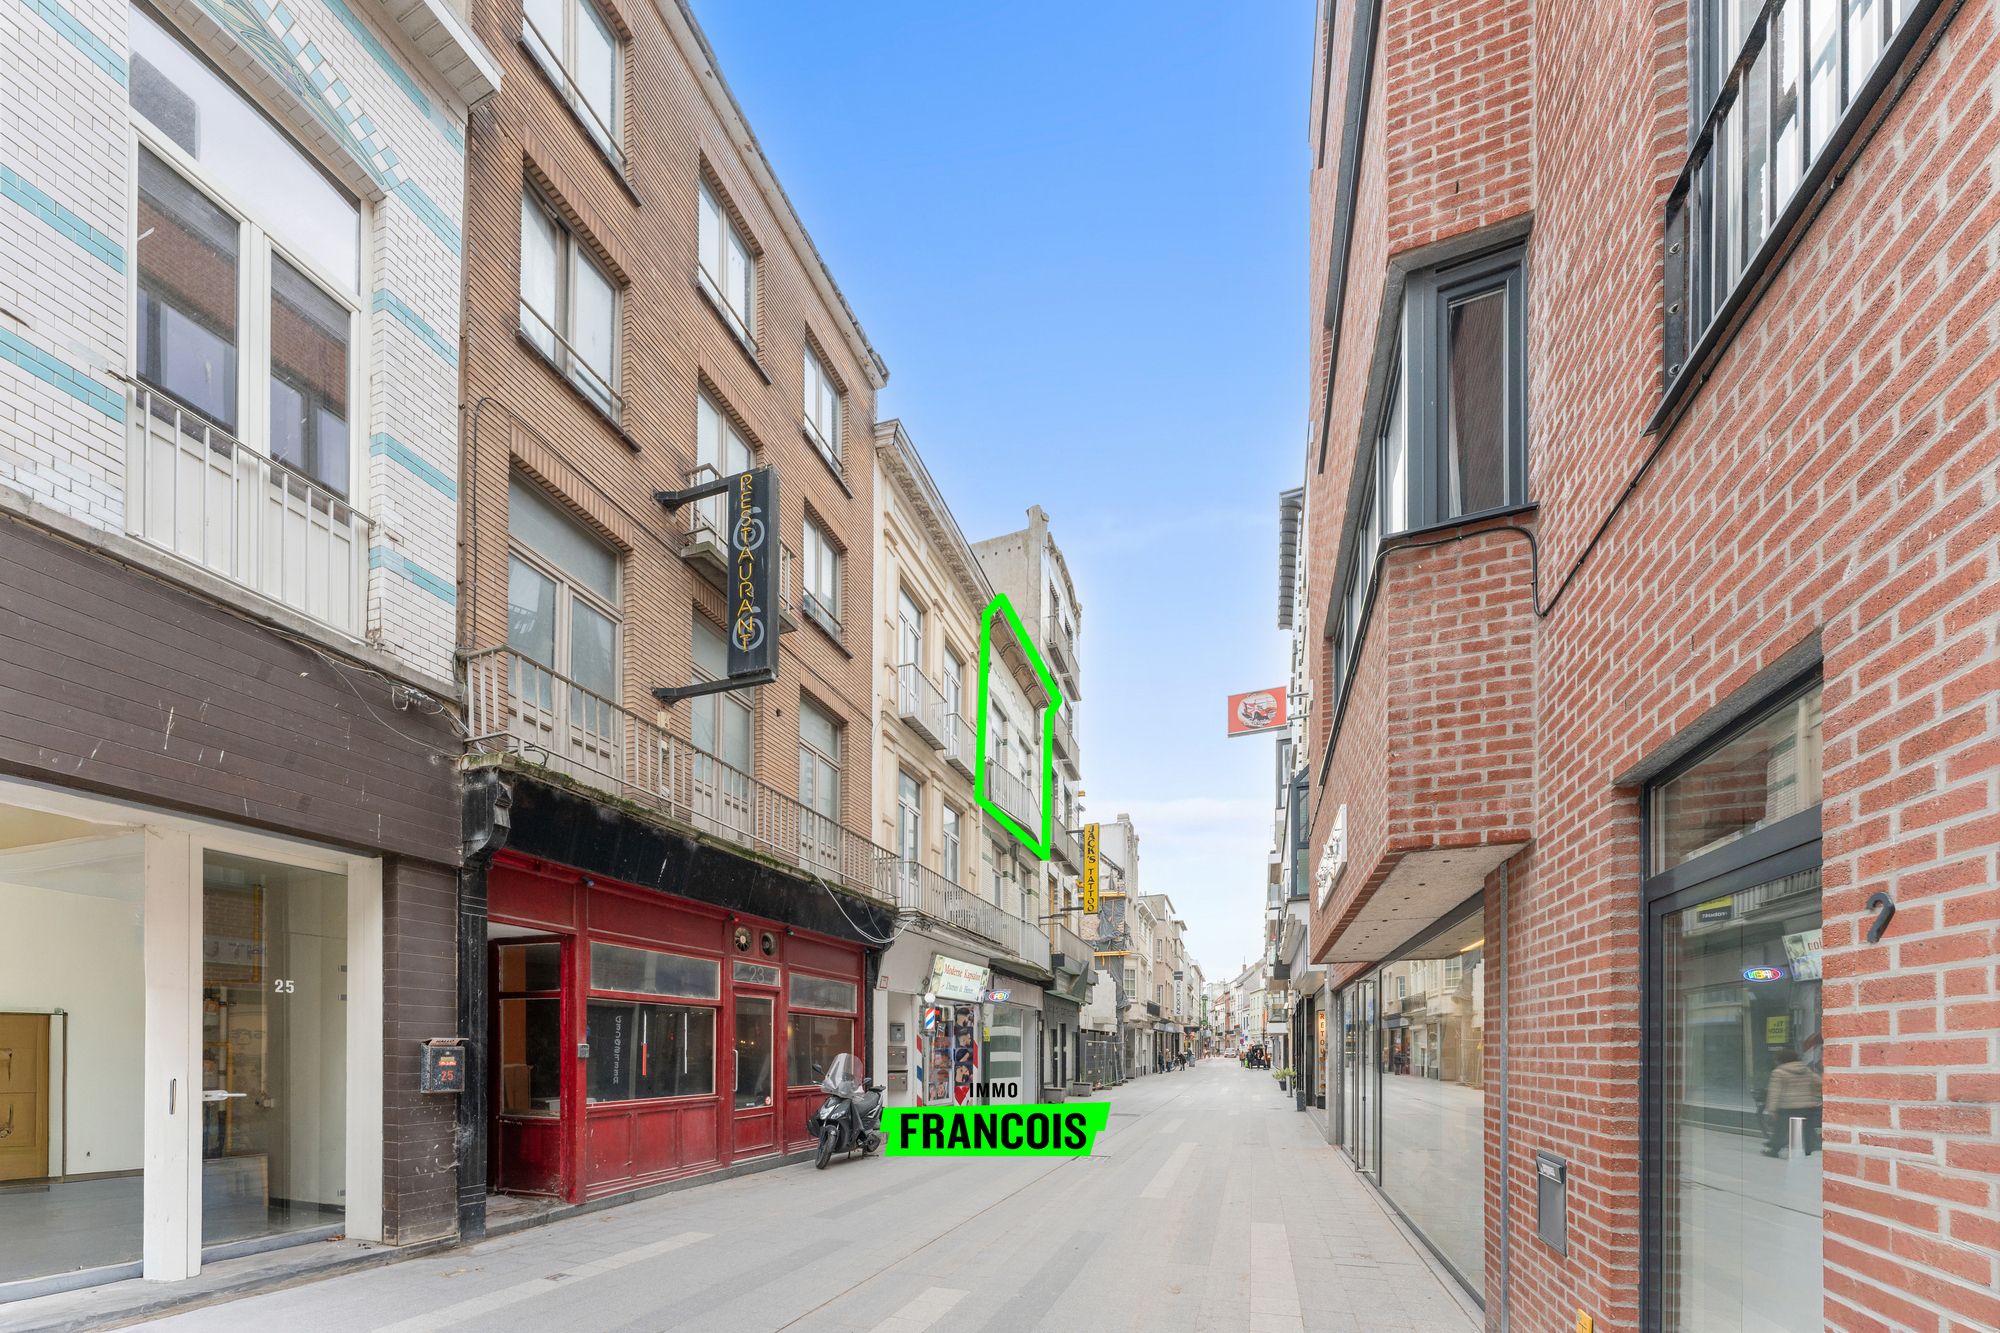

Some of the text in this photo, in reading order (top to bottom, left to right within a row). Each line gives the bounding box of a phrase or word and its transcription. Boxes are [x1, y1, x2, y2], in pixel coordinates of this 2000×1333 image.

[737, 473, 754, 652] RESTAURANT
[1087, 825, 1096, 912] JACK'S TATTOO
[1865, 891, 1896, 944] 7
[274, 979, 295, 993] 25
[749, 966, 765, 983] 23
[441, 1070, 454, 1081] 25
